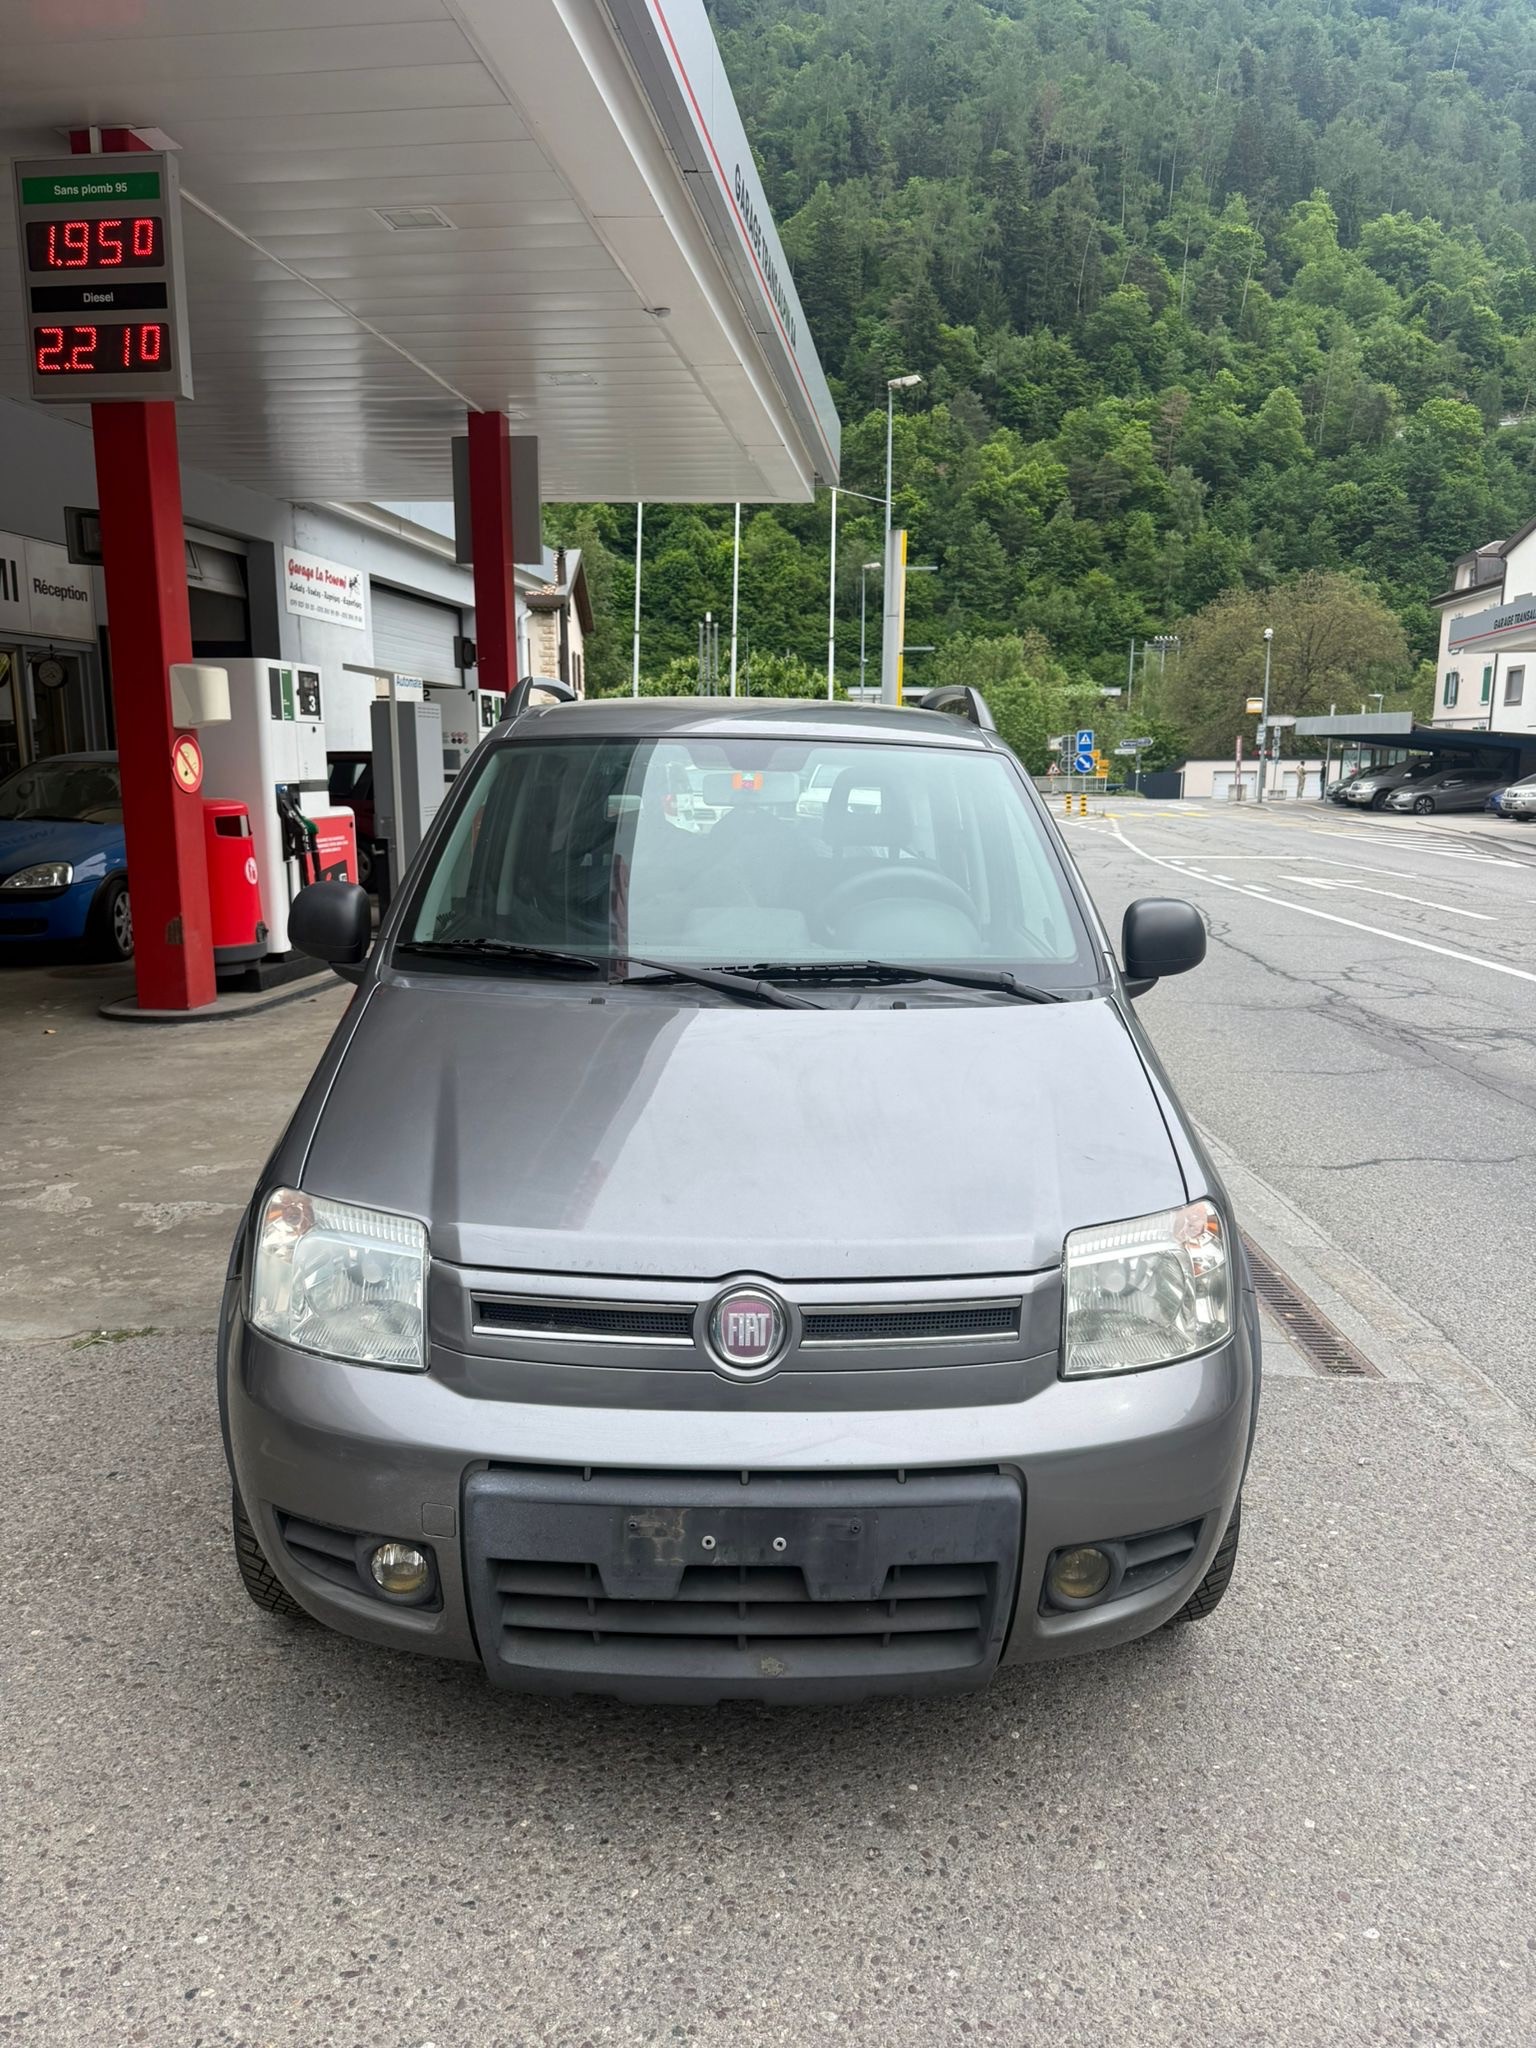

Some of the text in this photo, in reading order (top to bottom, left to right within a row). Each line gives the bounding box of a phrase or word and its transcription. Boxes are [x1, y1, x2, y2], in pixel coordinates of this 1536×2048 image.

[54, 182, 128, 196] Sans plomb 95
[734, 163, 761, 260] GARAGE
[48, 219, 154, 266] 1.950
[83, 292, 114, 303] Diesel
[38, 325, 160, 370] 2.210
[288, 558, 313, 581] Garage
[315, 567, 323, 581] La
[33, 577, 88, 602] Réception
[1493, 614, 1514, 630] GARAGE
[308, 695, 316, 712] 3
[423, 689, 431, 702] 2
[467, 689, 475, 702] 1
[728, 1312, 770, 1346] FIAT
